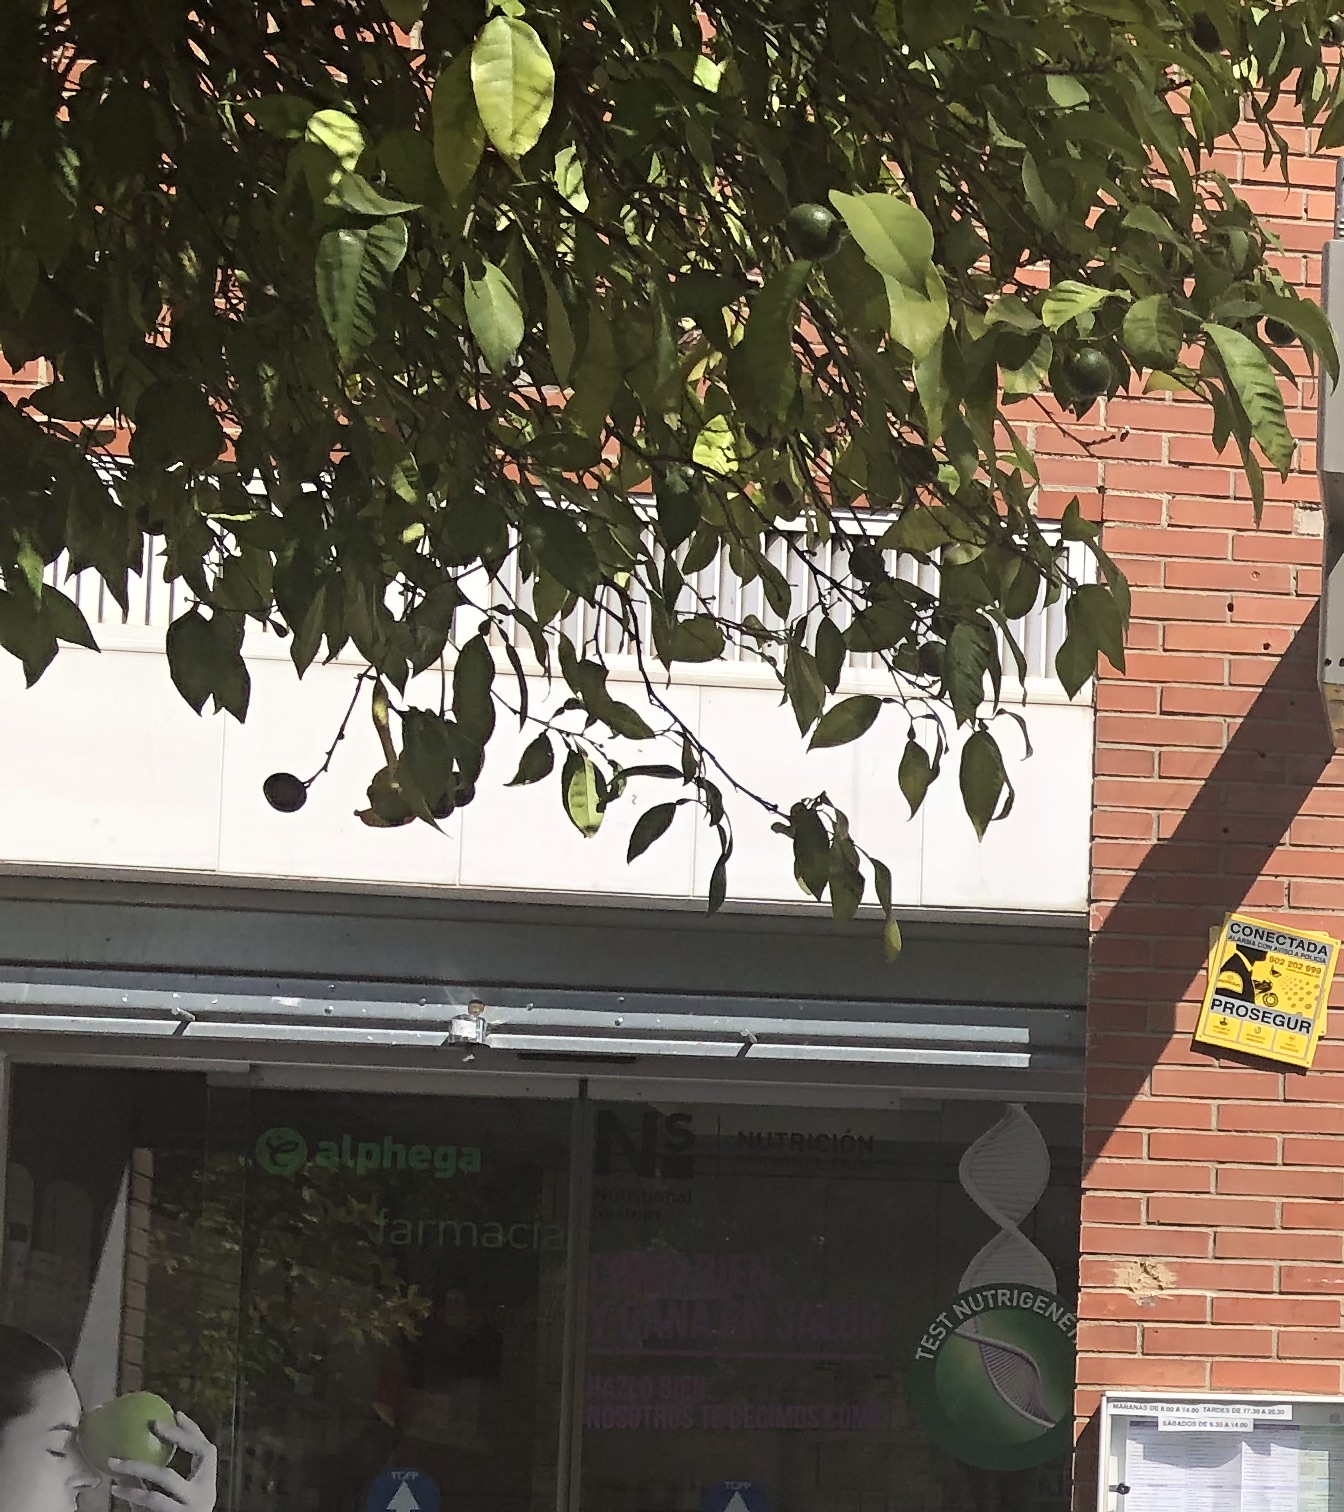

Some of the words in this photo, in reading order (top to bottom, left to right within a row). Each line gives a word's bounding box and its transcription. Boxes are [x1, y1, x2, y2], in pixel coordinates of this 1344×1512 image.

[1230, 922, 1328, 957] CONECTADA
[1287, 960, 1304, 970] 202
[1210, 998, 1312, 1034] PROSEGUR
[316, 1133, 483, 1179] alphega
[736, 1127, 876, 1154] NUTRICIÓN
[374, 1207, 568, 1250] farmacia
[915, 1314, 952, 1362] TEST
